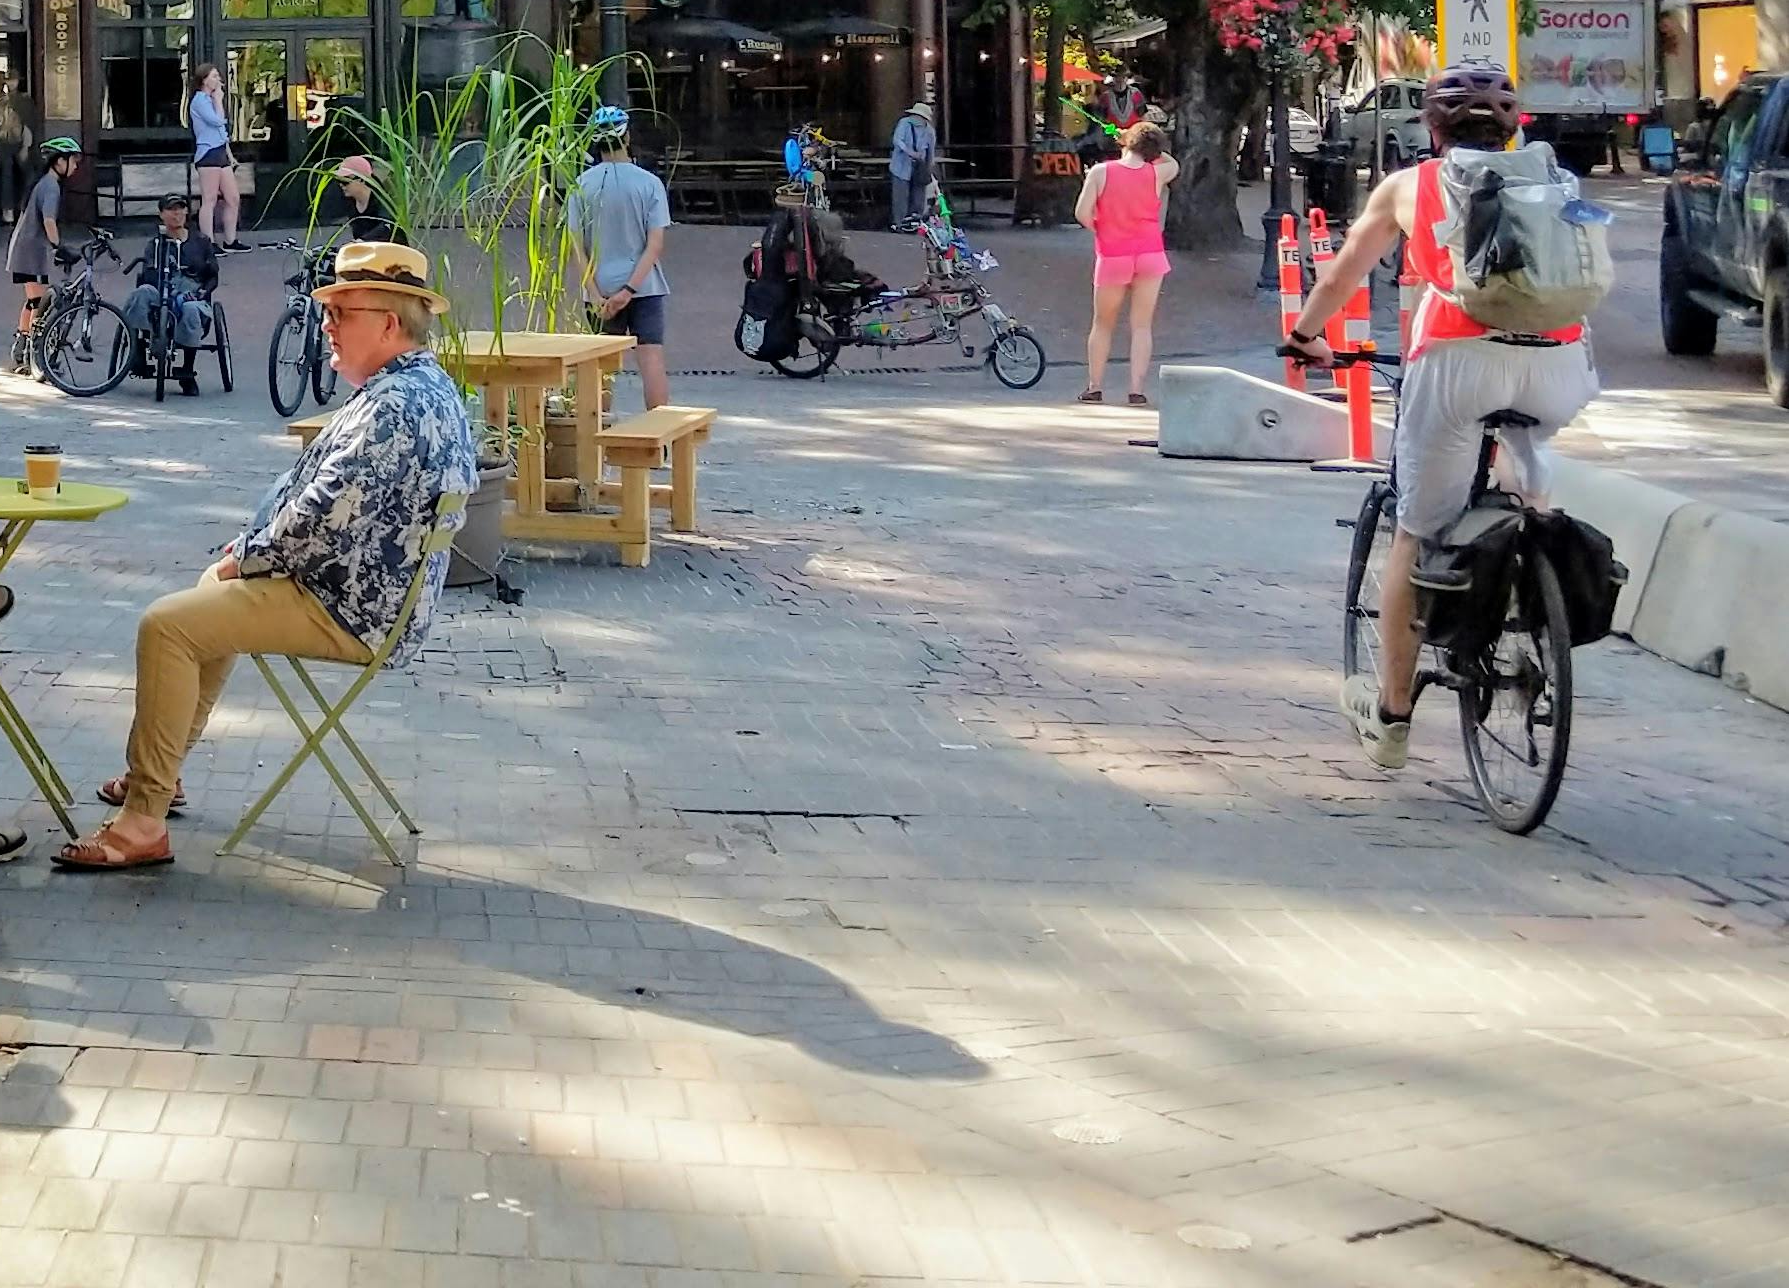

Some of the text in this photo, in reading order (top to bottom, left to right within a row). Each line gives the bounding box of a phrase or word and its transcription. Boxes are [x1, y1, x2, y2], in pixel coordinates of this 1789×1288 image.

[1537, 8, 1630, 29] Gordon
[55, 12, 69, 50] BOOT
[1462, 31, 1492, 47] AND
[1032, 153, 1082, 176] OPEN
[1314, 240, 1331, 252] TE
